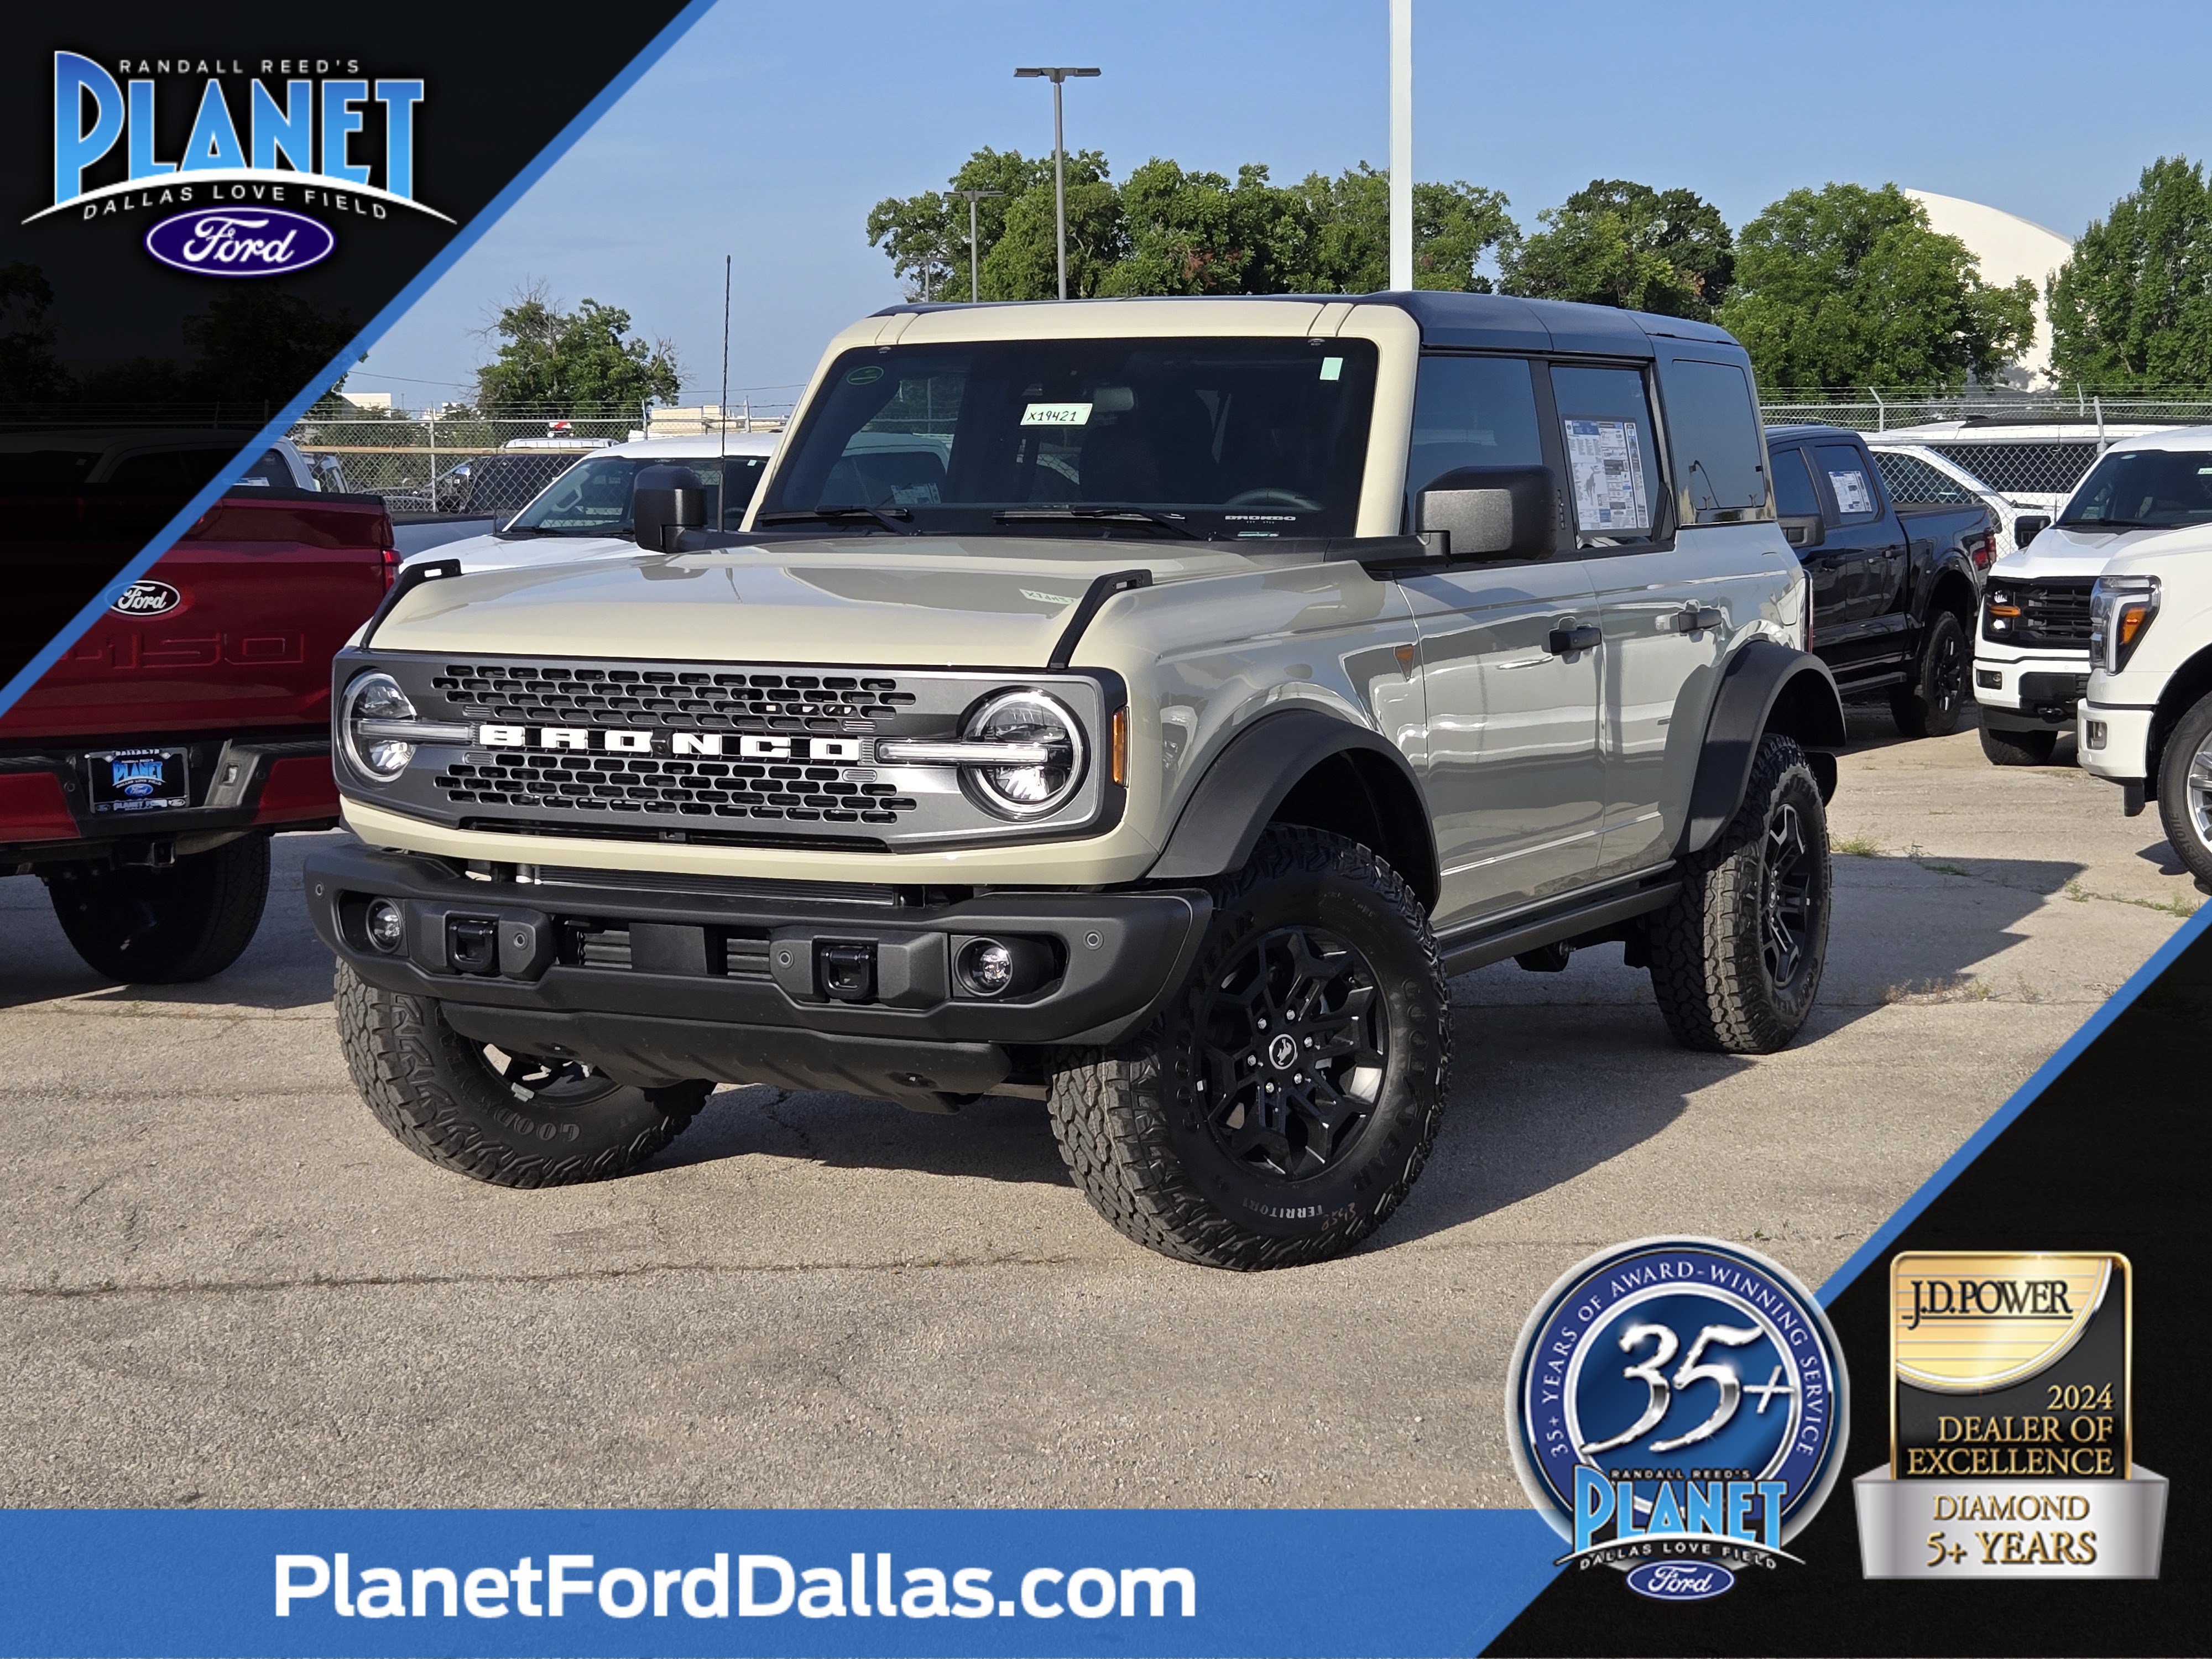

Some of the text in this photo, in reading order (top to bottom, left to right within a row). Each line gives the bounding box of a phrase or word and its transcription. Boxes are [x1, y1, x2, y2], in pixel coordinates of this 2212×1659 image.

[1026, 410, 1077, 421] X19421
[117, 585, 168, 609] Ford
[479, 723, 860, 762] BRONCO
[113, 761, 163, 784] PLANET
